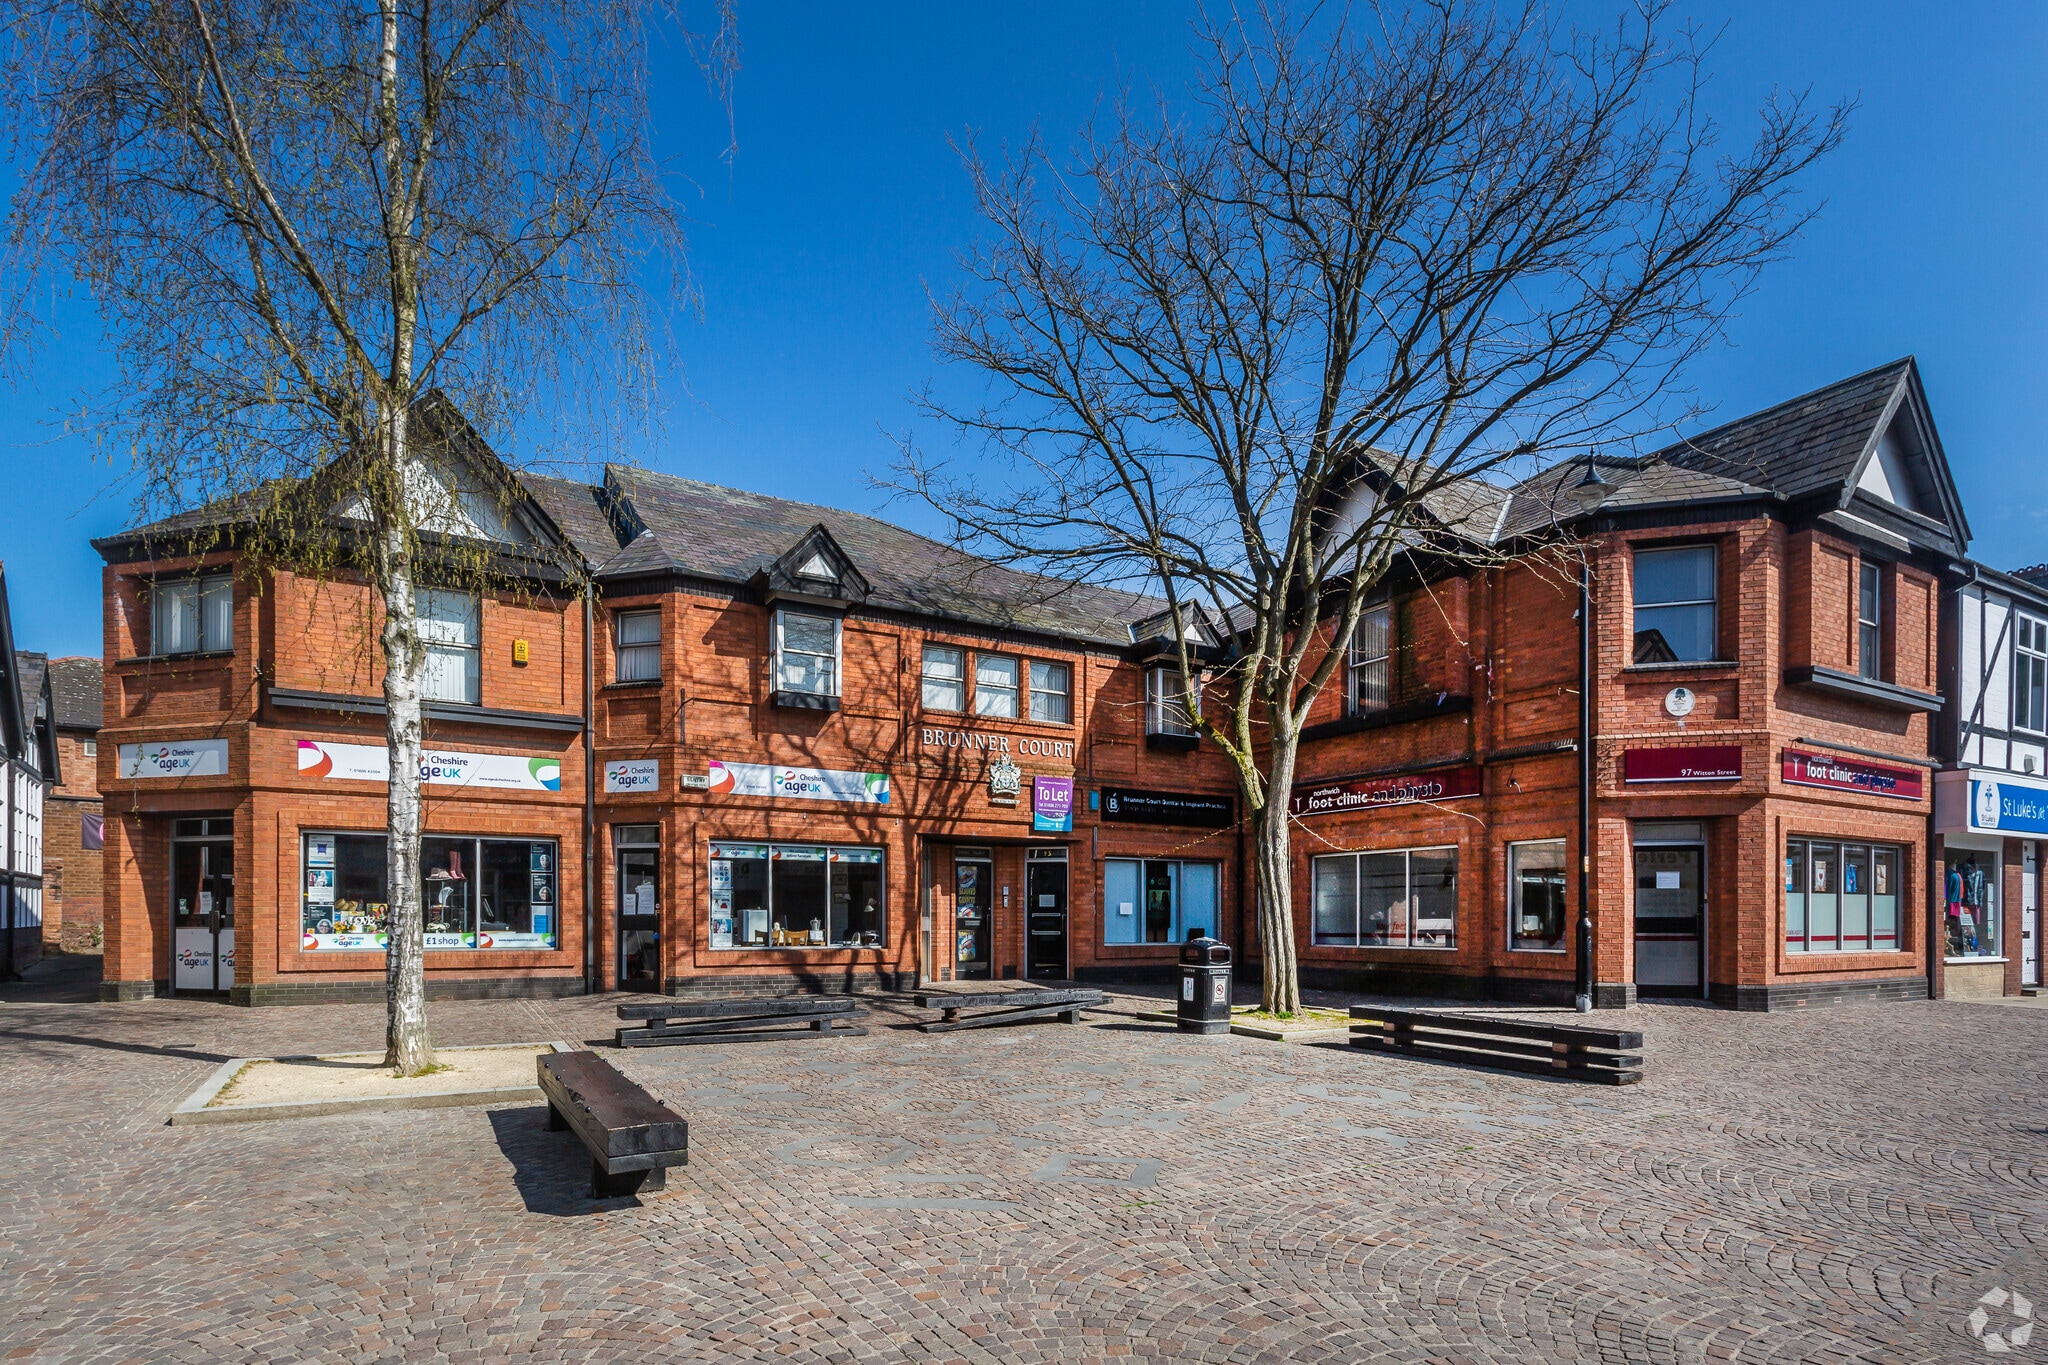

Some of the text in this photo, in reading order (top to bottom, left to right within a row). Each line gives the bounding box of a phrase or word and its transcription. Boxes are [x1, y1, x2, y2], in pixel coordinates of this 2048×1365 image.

[922, 728, 1074, 758] BRUNNER COURT
[172, 748, 194, 756] Cheshire
[431, 755, 468, 766] Cheshire
[631, 766, 655, 774] Cheshire
[1806, 761, 1827, 778] foot
[1829, 765, 1852, 783] clinic
[800, 774, 826, 782] Cheshire
[1038, 786, 1069, 802] To Let
[1308, 781, 1443, 809] foot clinic and physio
[1313, 787, 1340, 797] northwich
[2003, 798, 2012, 816] St
[2013, 799, 2037, 819] Luke's
[350, 915, 376, 925] LOVE
[438, 937, 459, 946] shop
